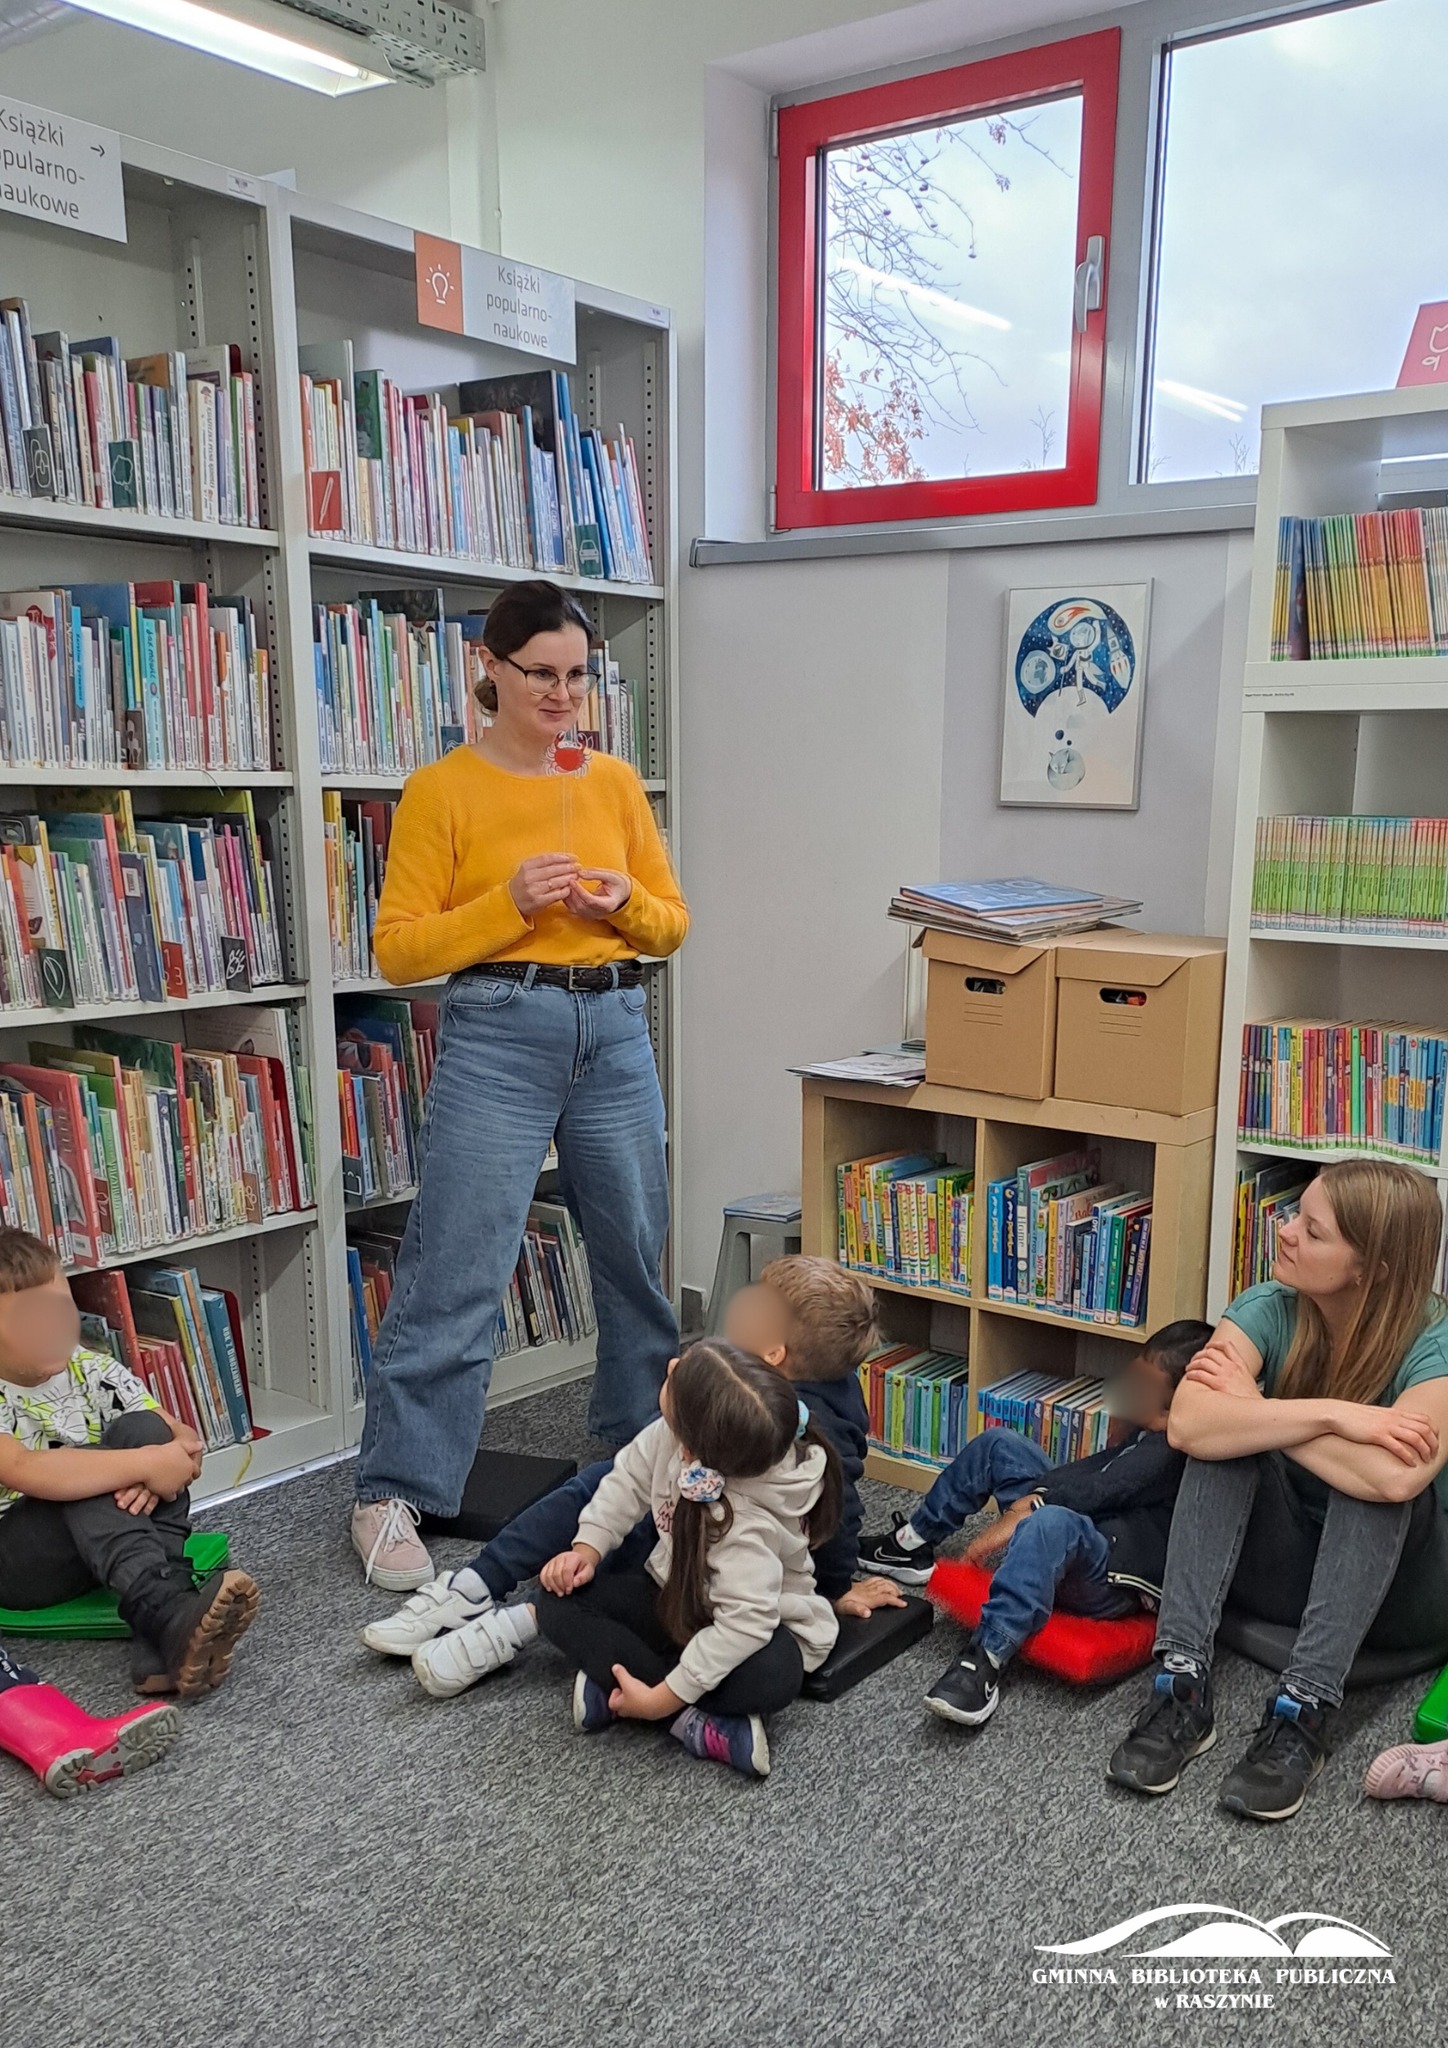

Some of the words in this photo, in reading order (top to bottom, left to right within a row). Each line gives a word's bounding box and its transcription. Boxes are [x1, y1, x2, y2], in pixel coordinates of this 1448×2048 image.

[0, 148, 86, 185] pularno-
[0, 183, 80, 219] aukowe
[497, 264, 540, 294] Książki
[486, 293, 553, 322] popularno-
[493, 322, 548, 349] naukowe
[1017, 1215, 1026, 1248] Home
[1036, 1255, 1044, 1279] SNOW
